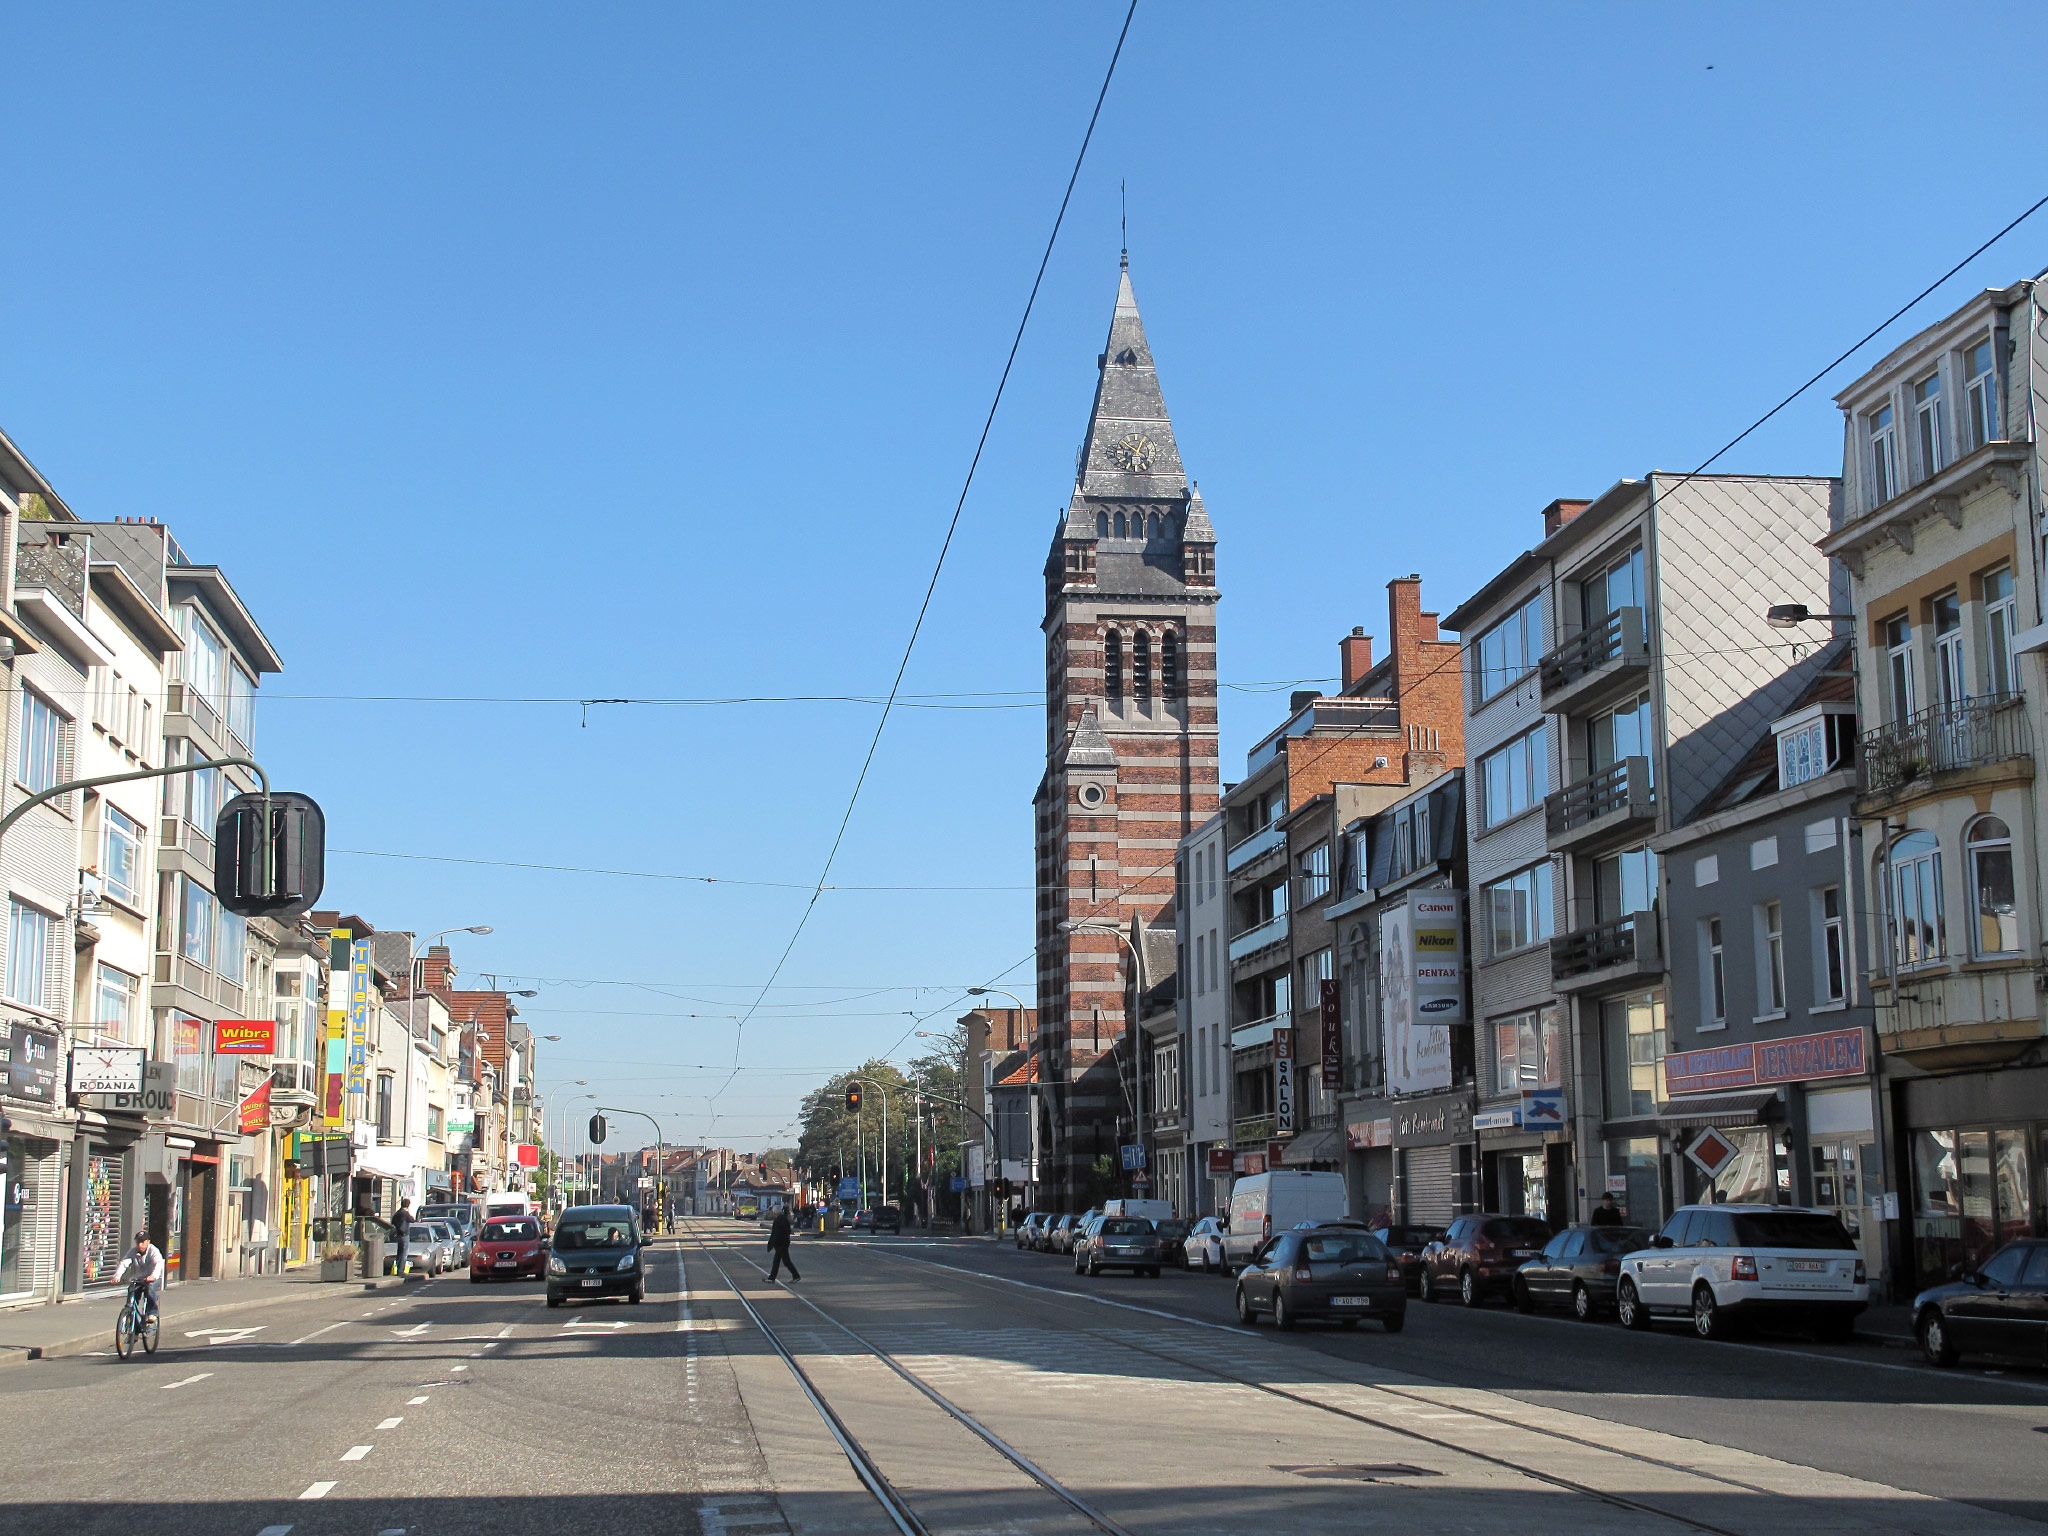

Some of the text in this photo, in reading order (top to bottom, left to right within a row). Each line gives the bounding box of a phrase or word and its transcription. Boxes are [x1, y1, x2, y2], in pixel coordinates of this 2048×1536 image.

[1417, 903, 1454, 912] Canon
[1418, 935, 1454, 946] Nikon
[1418, 968, 1456, 977] PENTAX
[1424, 1001, 1453, 1009] SAMSUNG
[351, 946, 368, 1088] Telefusion
[1326, 981, 1340, 1055] Souk
[221, 1026, 270, 1038] Wibra
[1758, 1033, 1862, 1080] JERUZALEM
[79, 1080, 136, 1091] RODANIA
[1279, 1061, 1291, 1128] SALON
